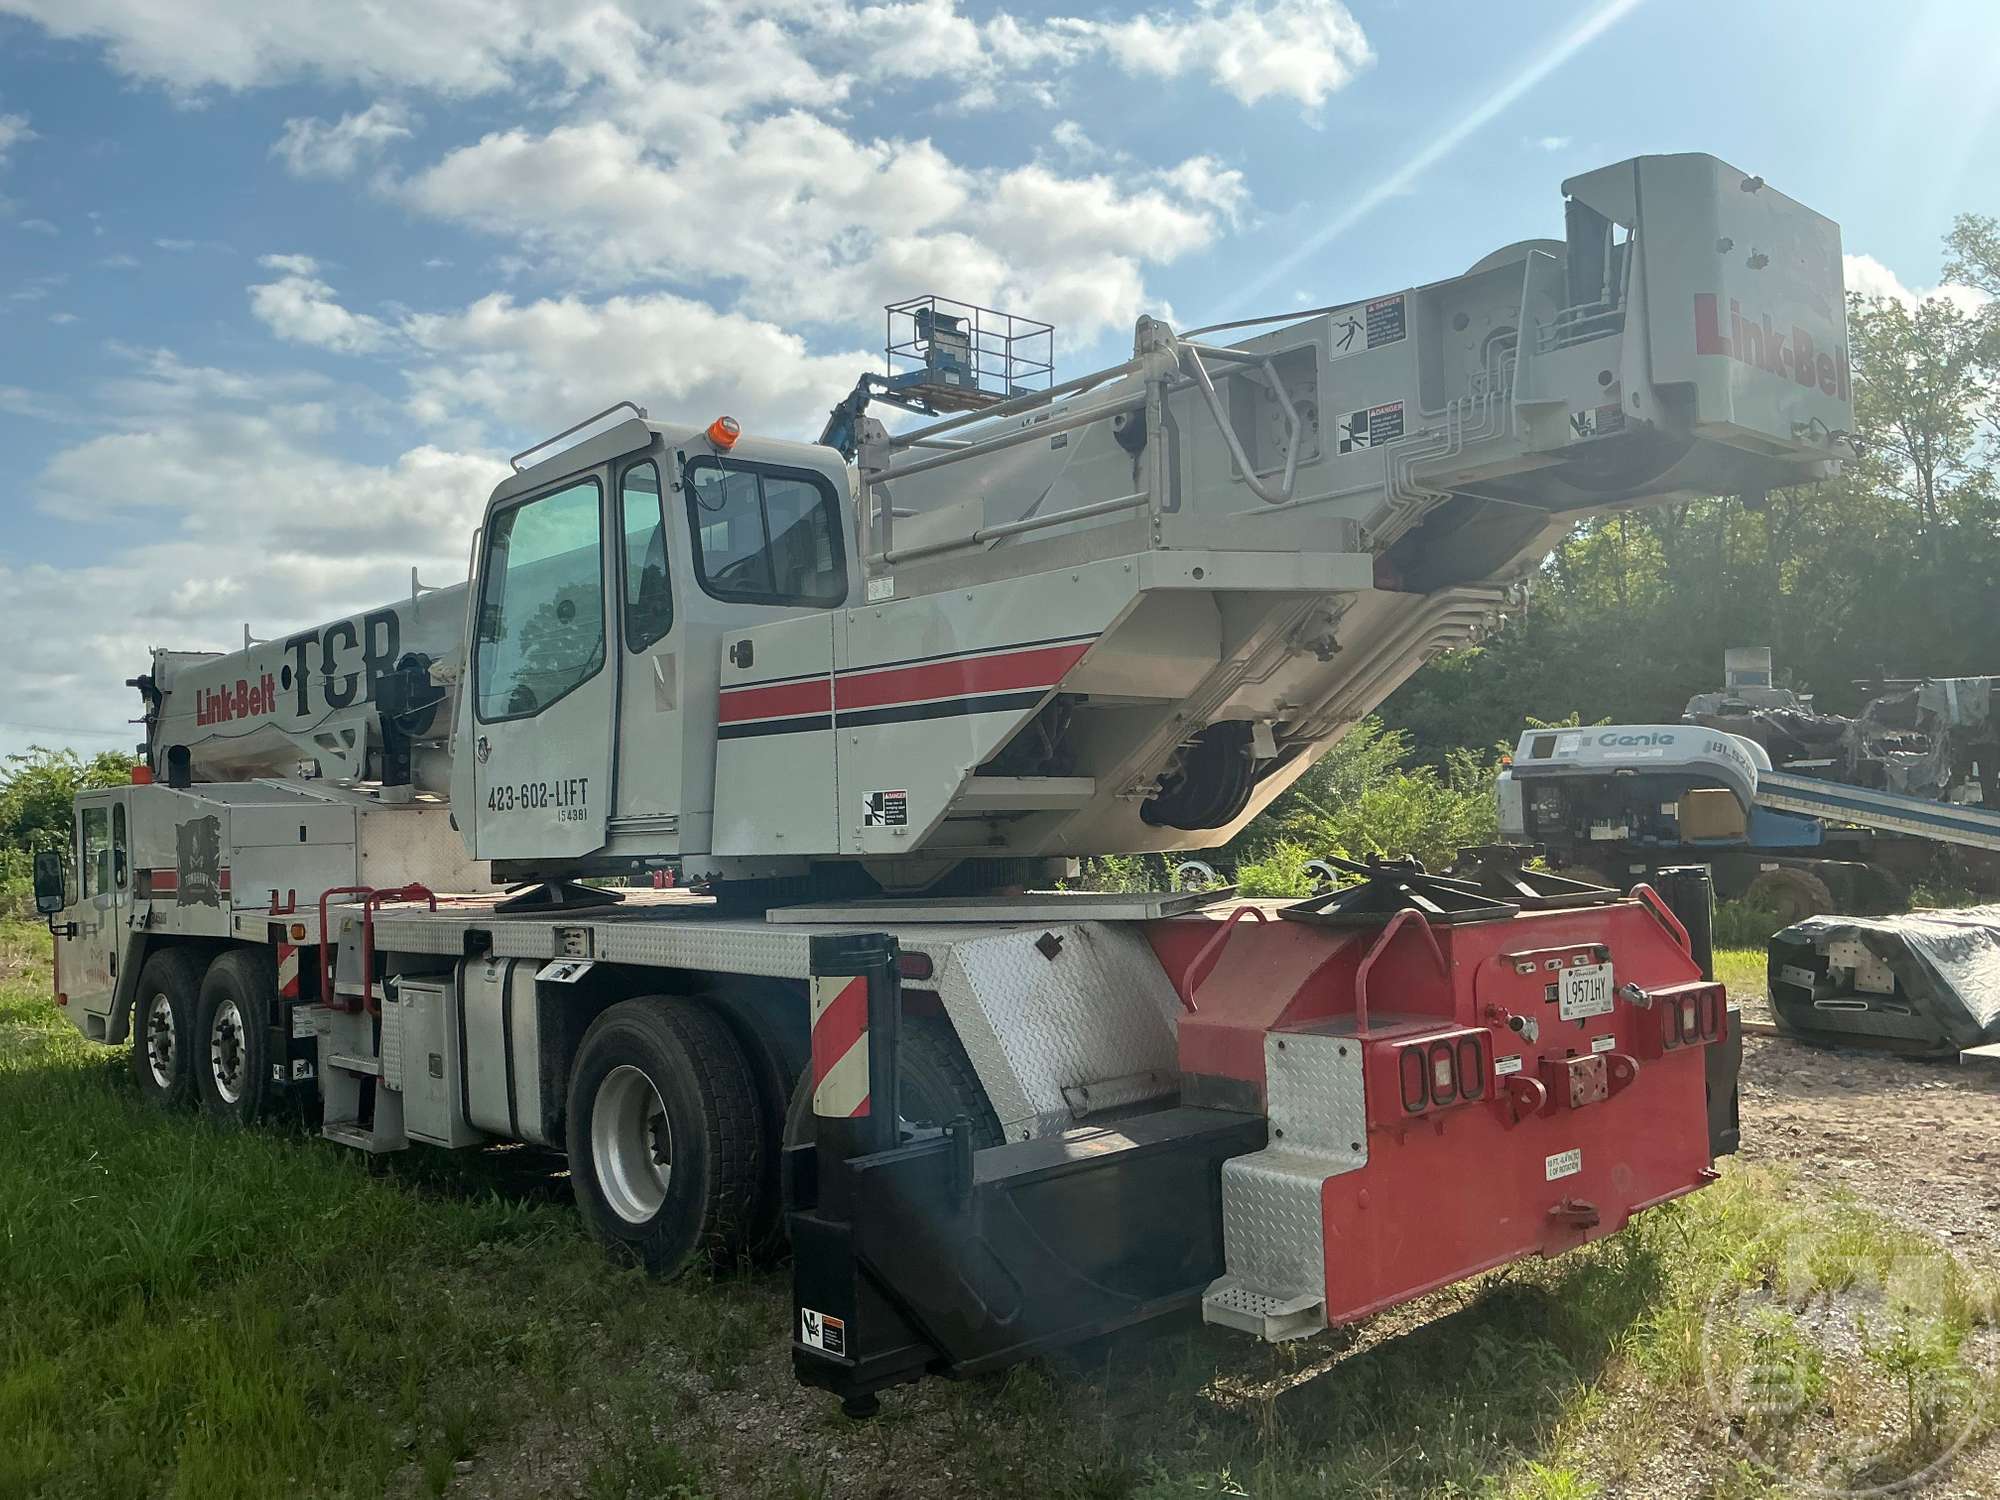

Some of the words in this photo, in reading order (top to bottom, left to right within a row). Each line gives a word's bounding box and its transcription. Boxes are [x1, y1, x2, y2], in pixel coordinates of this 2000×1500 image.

[196, 672, 277, 727] Link-Belt
[1598, 733, 1675, 747] Genie
[488, 778, 589, 812] 423-602-LIFT
[1565, 976, 1606, 1005] L9571HY
